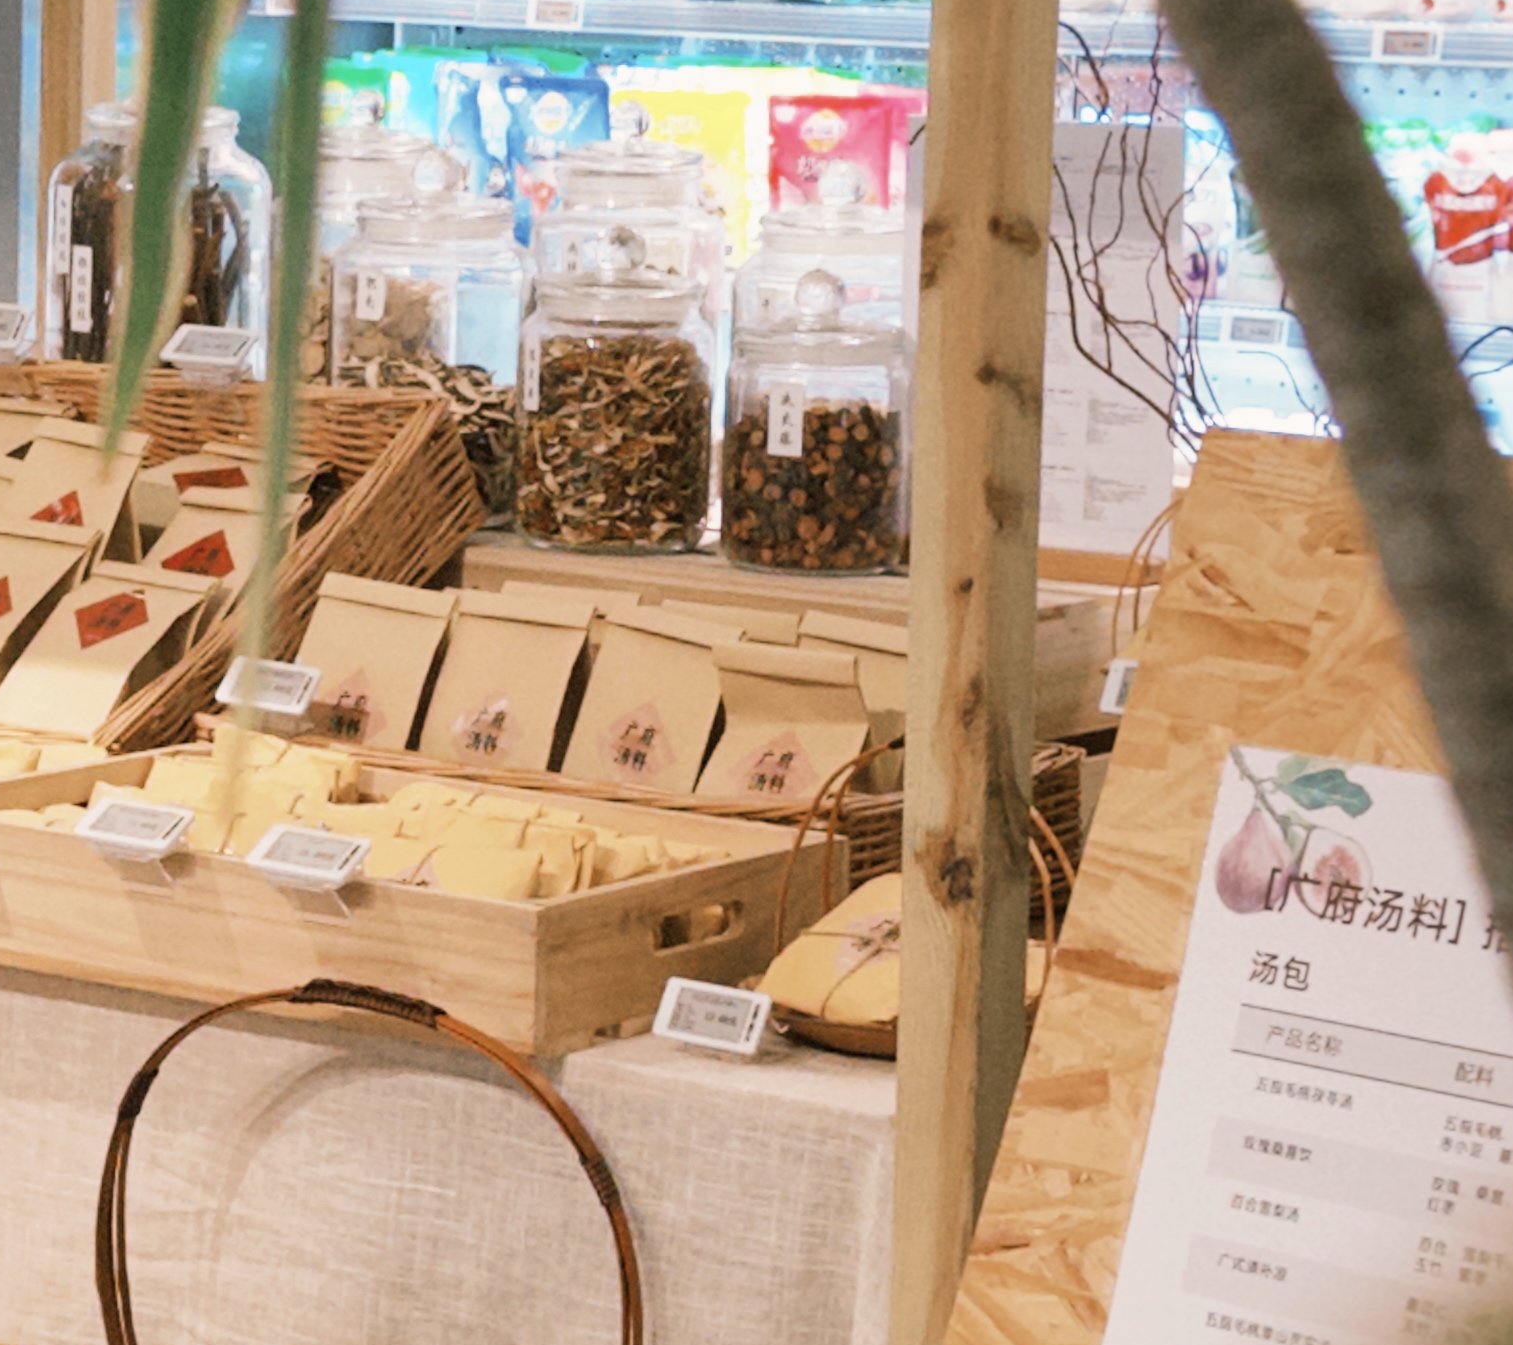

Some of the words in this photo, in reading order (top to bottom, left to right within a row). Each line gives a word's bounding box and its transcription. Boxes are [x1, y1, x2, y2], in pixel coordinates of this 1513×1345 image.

[620, 720, 656, 746] 广府
[614, 745, 647, 771] 汤料
[756, 749, 794, 769] 广府
[748, 772, 786, 794] 汤料
[1263, 867, 1467, 945] [广府汤料]
[1248, 950, 1312, 992] 汤包
[1265, 1024, 1344, 1056] 产品名称
[1454, 1061, 1494, 1086] 配料
